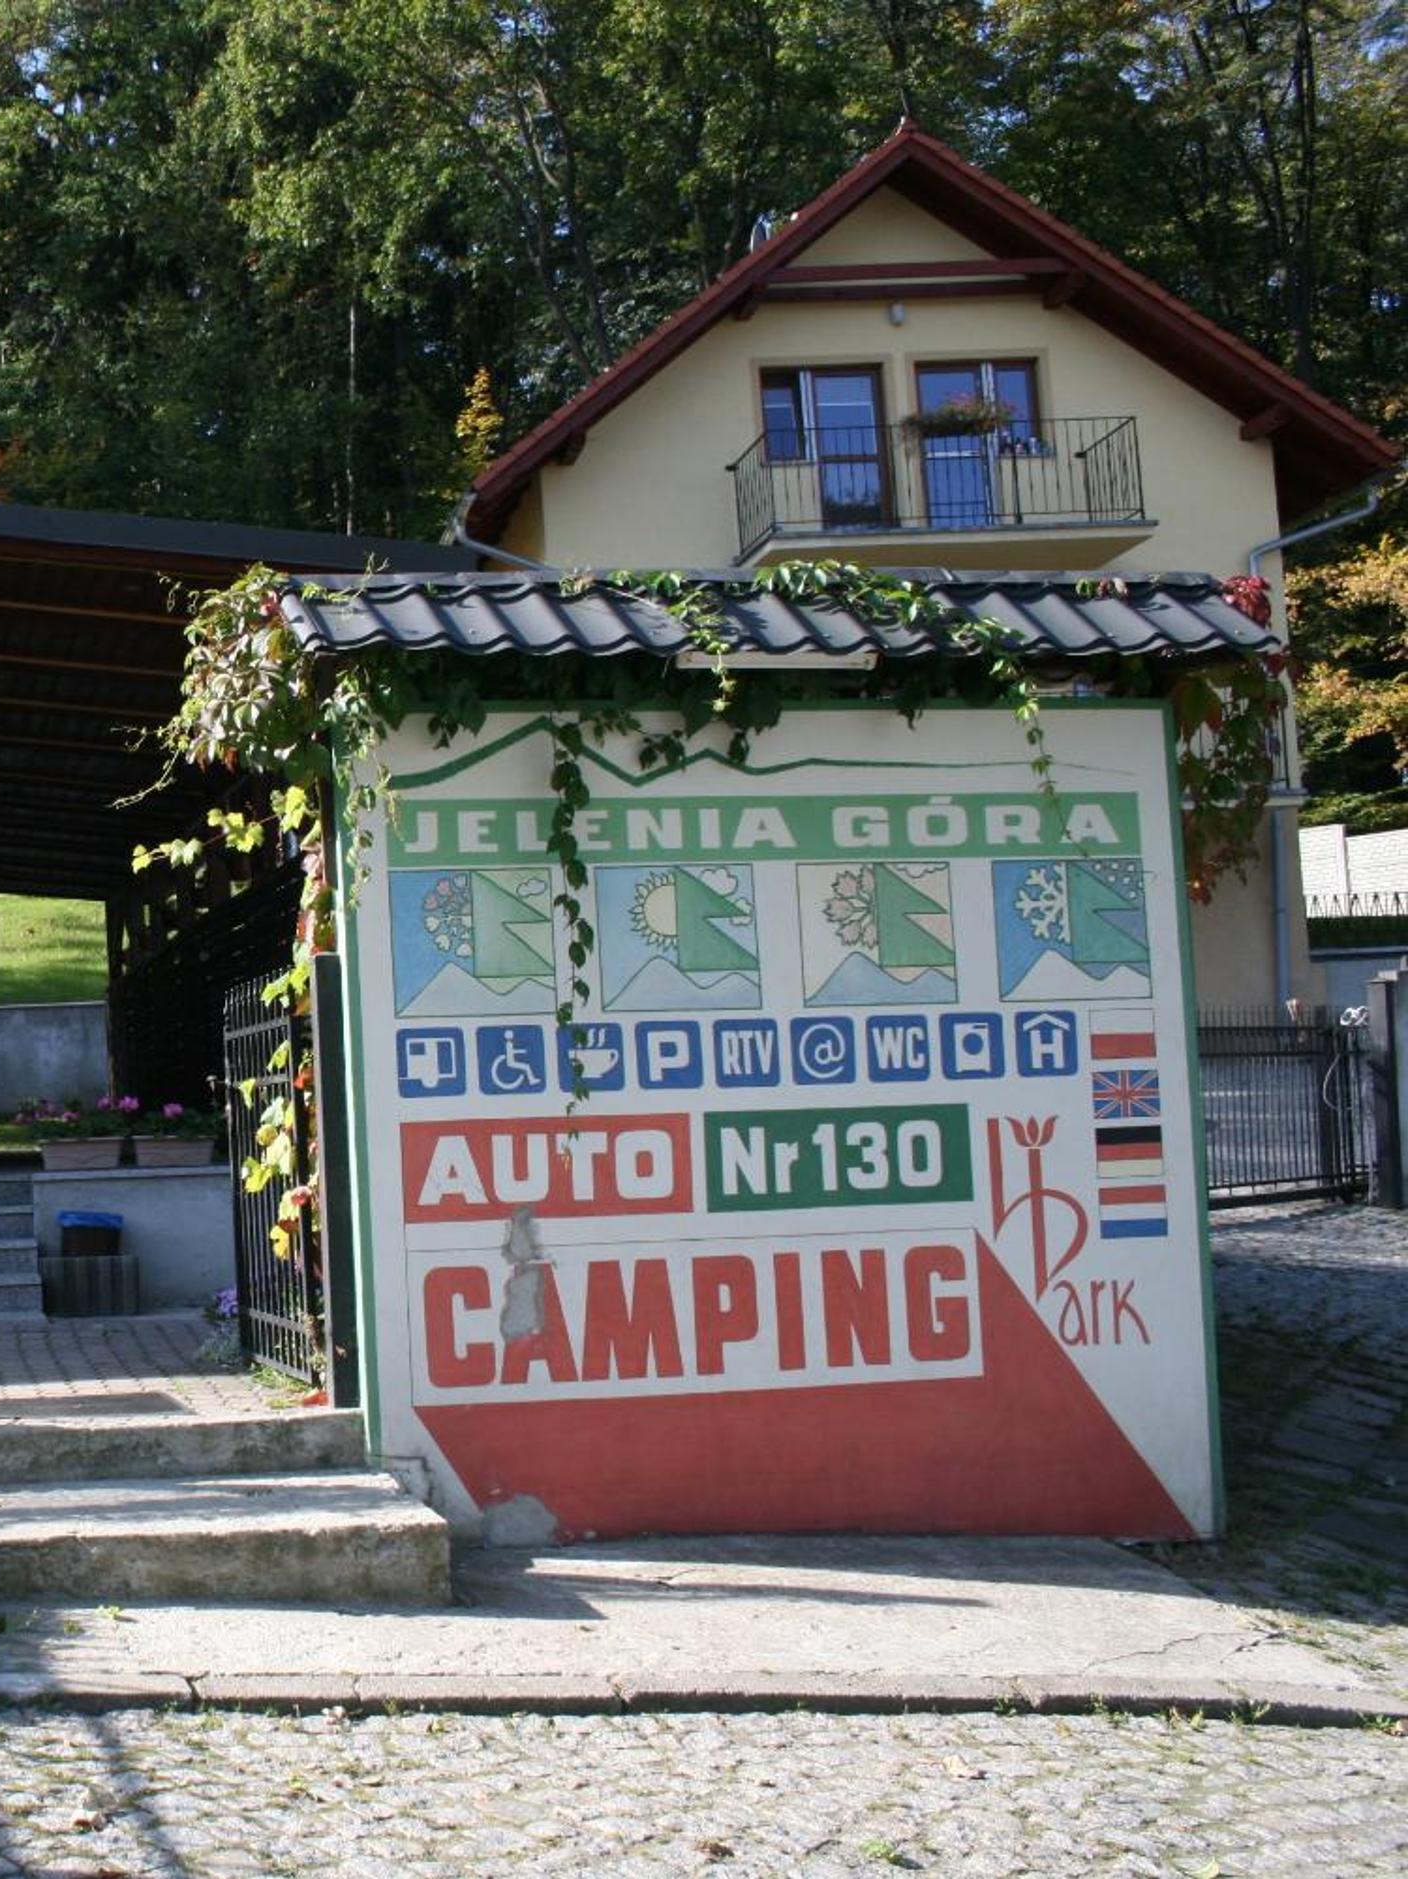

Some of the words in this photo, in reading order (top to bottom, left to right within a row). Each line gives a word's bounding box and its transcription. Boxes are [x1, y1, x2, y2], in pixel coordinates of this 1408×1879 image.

[404, 806, 798, 852] JELENIA
[831, 795, 1121, 849] GÓRA
[646, 1030, 690, 1082] P
[721, 1030, 774, 1076] RTV
[872, 1025, 927, 1070] WC
[417, 1129, 675, 1206] AUTO
[423, 1244, 971, 1388] CAMPING
